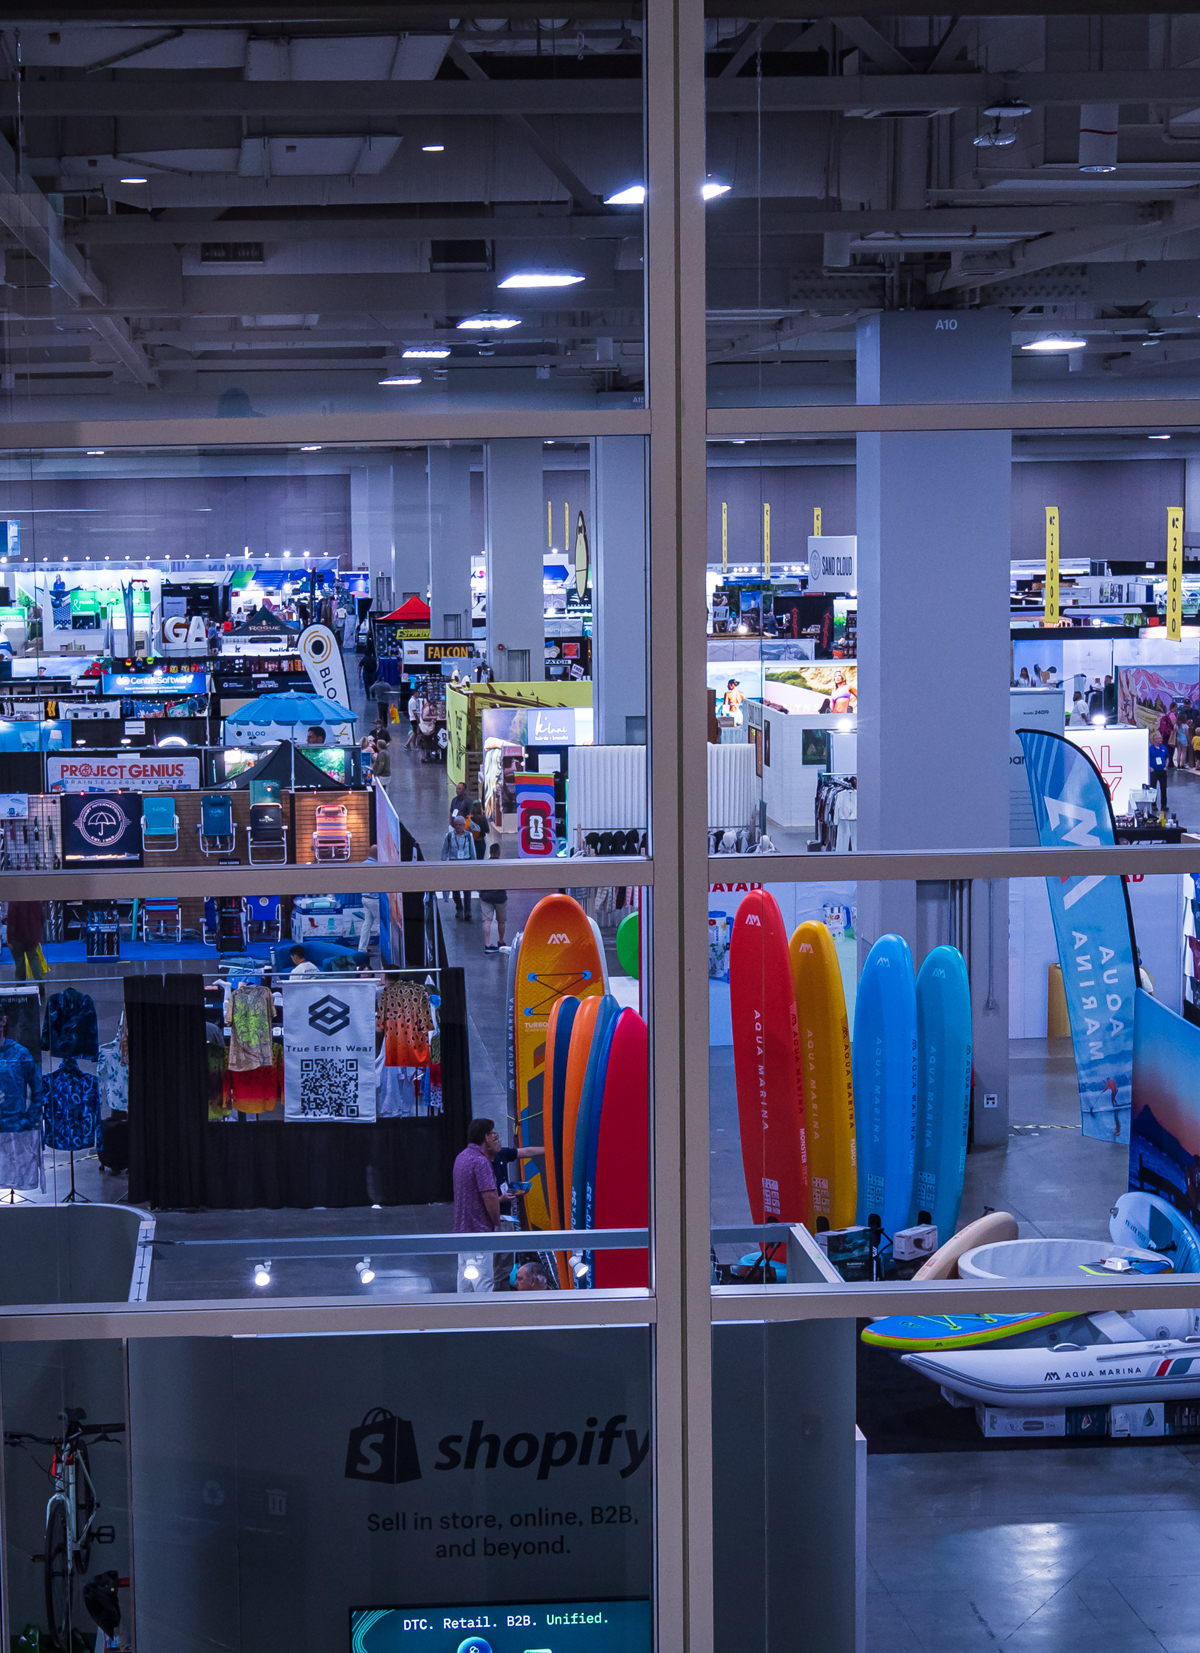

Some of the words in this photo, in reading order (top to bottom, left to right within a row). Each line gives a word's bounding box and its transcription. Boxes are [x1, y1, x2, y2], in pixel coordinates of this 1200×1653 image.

[935, 319, 958, 330] A10
[822, 556, 835, 575] SAND
[836, 556, 852, 575] CLOUD
[428, 646, 469, 659] FALCON
[319, 666, 341, 704] BLO
[128, 763, 184, 778] GENIUS
[286, 1045, 310, 1053] True
[314, 1045, 342, 1053] Earth
[345, 1045, 373, 1053] Wear
[754, 1009, 764, 1056] AQUA
[792, 1031, 800, 1063] AQUA
[807, 1028, 816, 1071] AQUA
[928, 1045, 937, 1084] AQUA
[758, 1065, 769, 1130] MARINA
[810, 1079, 820, 1140] MARINA
[846, 1082, 855, 1129] MARINA
[873, 1085, 881, 1143] MARINA
[925, 1091, 934, 1148] MARINA
[1065, 1370, 1094, 1379] AQUA
[1100, 1367, 1141, 1377] MARINA
[434, 1414, 650, 1480] shopify
[367, 1511, 407, 1531] Sell
[414, 1512, 432, 1530] in
[439, 1512, 503, 1530] store,
[510, 1507, 584, 1528] online,
[591, 1505, 639, 1525] B2B,
[436, 1538, 476, 1558] and
[483, 1535, 571, 1560] beyond.
[403, 1619, 434, 1631] DTC.
[443, 1616, 498, 1630] Retail.
[507, 1615, 537, 1627] B2B.
[546, 1612, 609, 1625] Unified.
